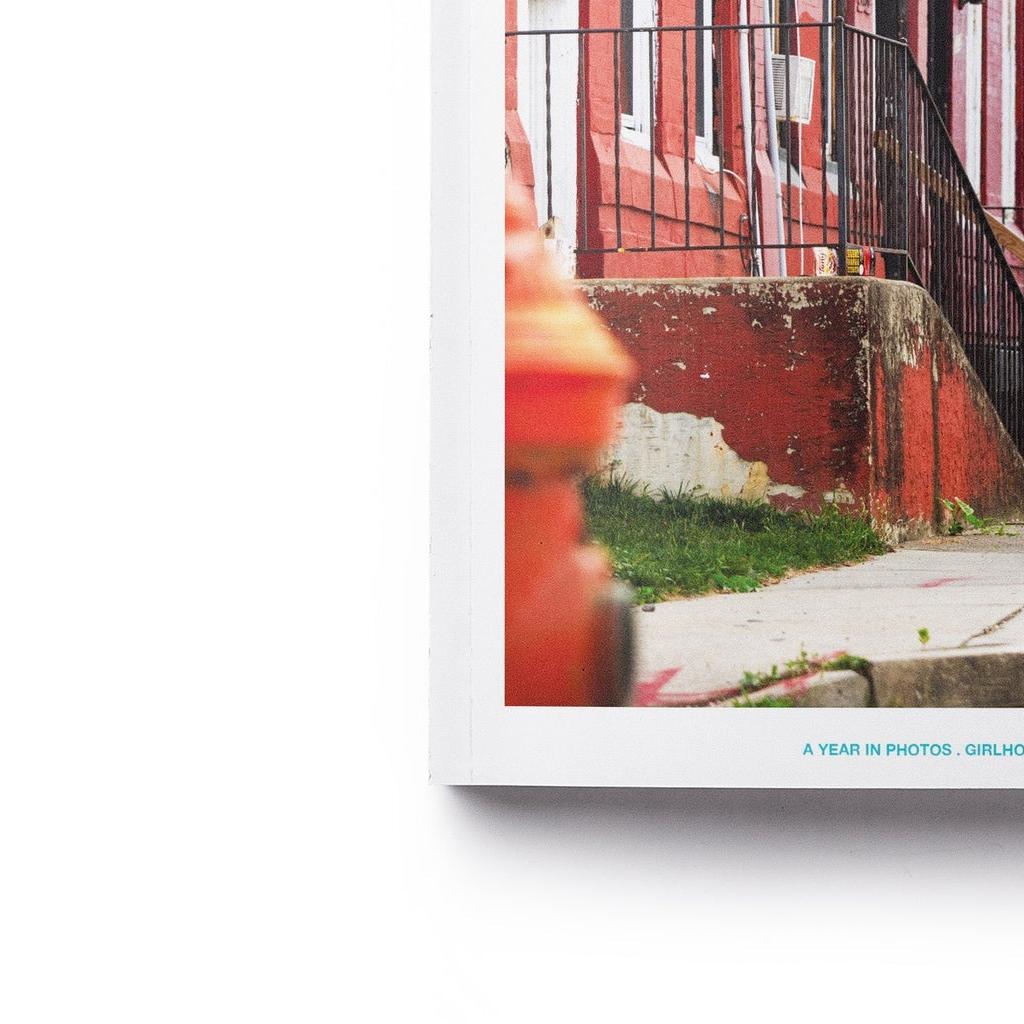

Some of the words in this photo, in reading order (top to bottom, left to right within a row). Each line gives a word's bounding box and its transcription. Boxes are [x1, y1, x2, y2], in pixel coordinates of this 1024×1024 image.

[803, 743, 814, 756] A
[818, 742, 861, 756] YEAR
[865, 743, 881, 756] IN
[885, 742, 952, 757] PHOTOS
